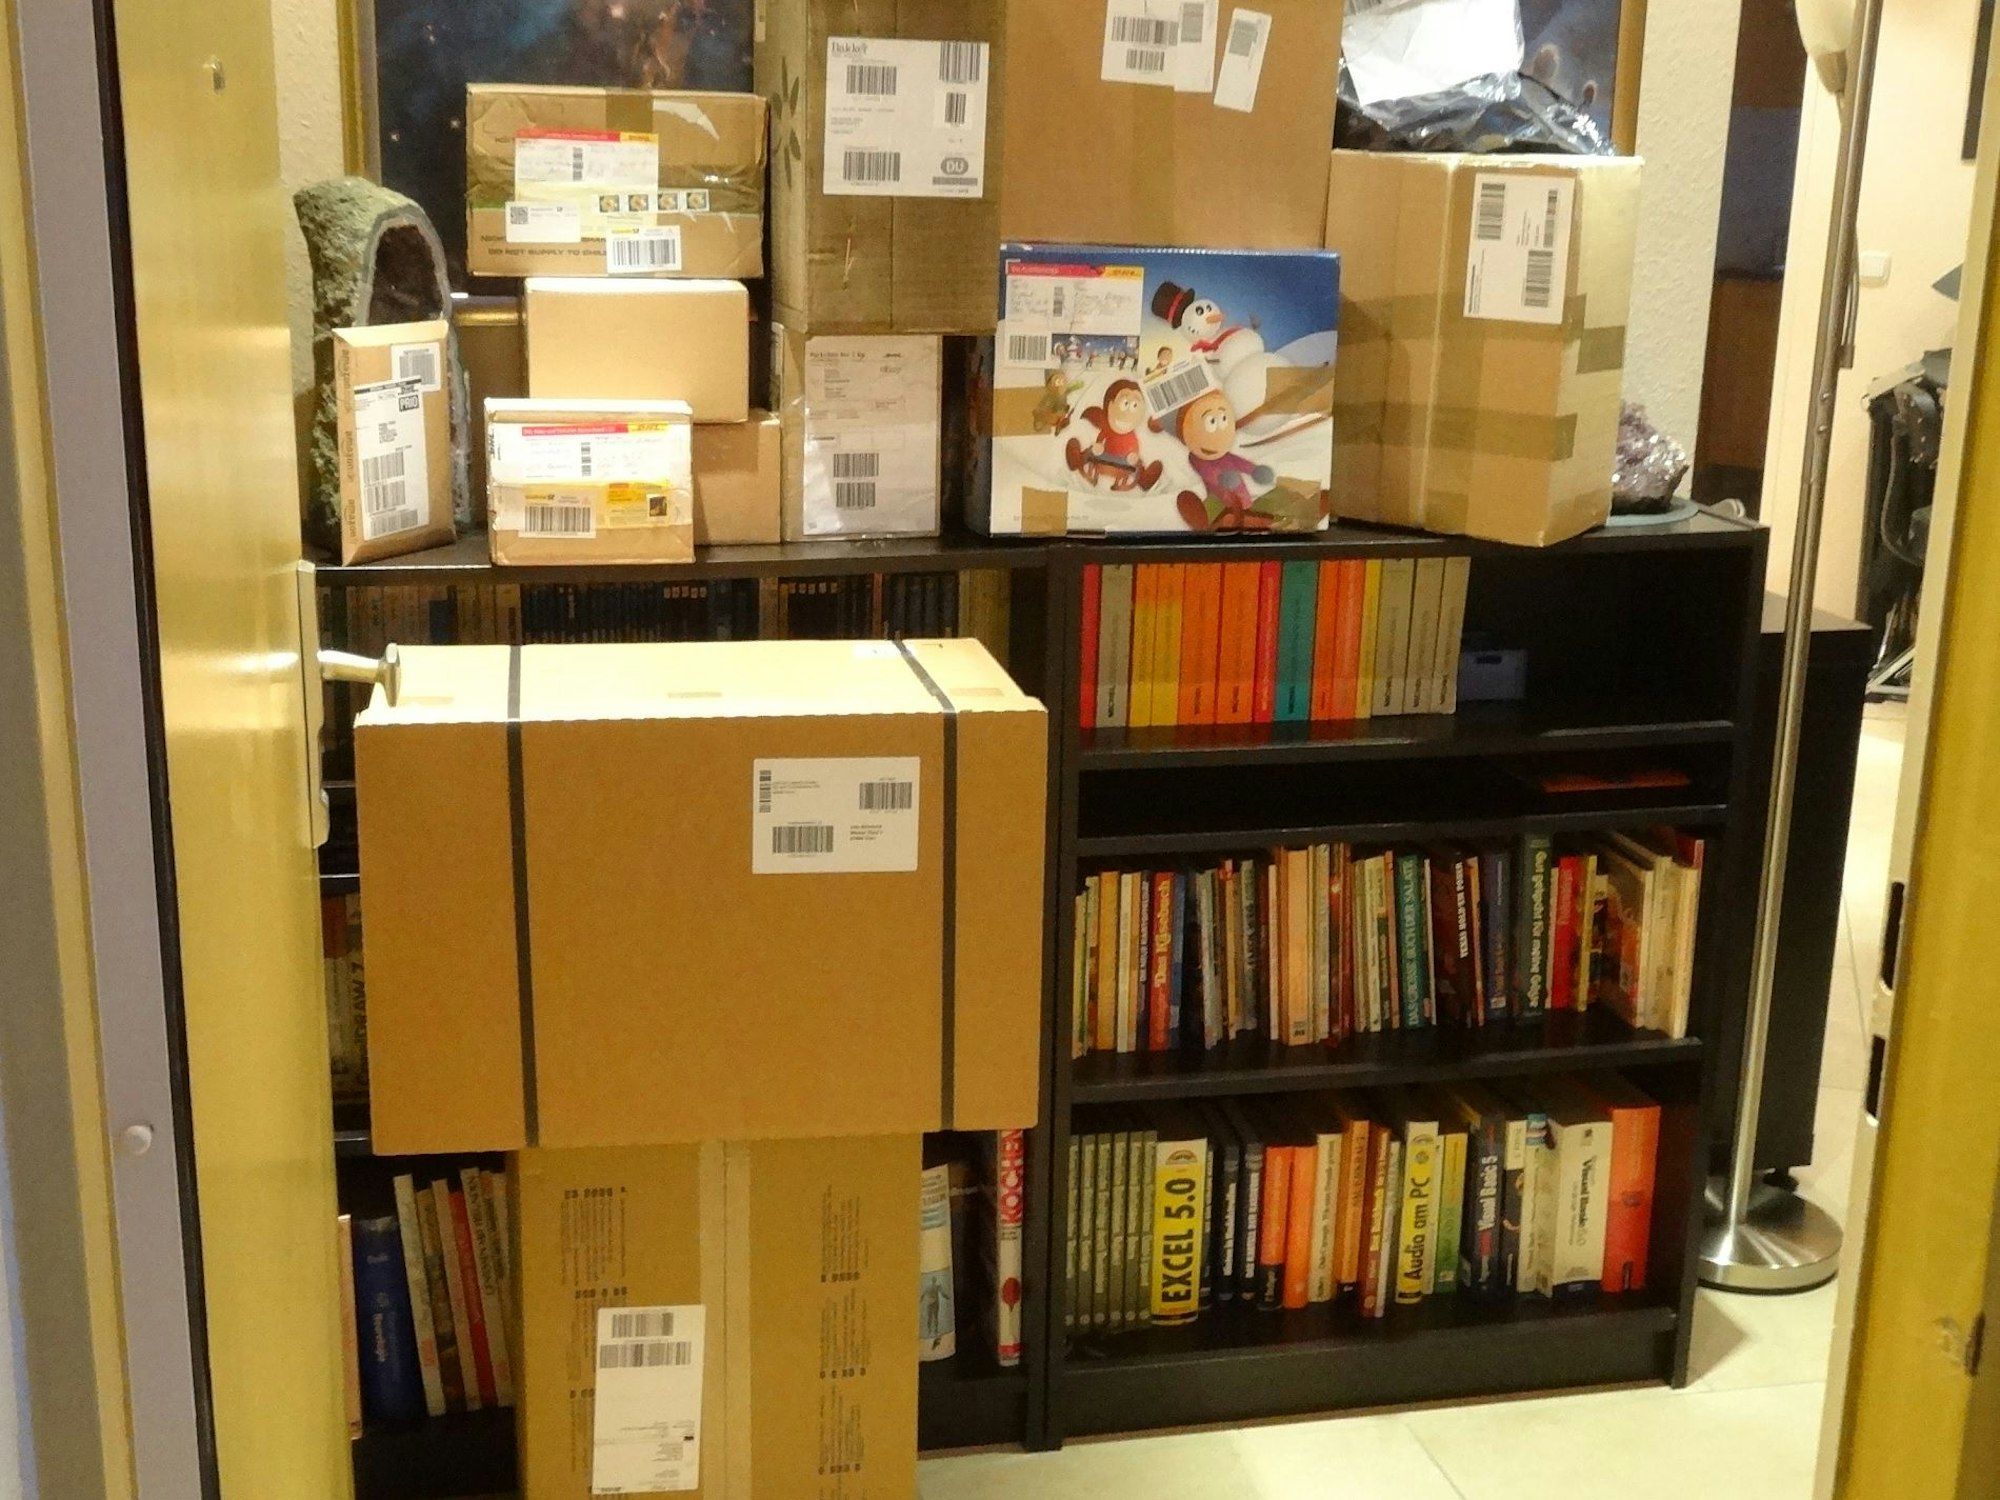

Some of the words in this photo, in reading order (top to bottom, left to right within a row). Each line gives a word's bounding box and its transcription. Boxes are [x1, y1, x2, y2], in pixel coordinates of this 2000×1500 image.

[528, 248, 563, 257] SUPPLY
[567, 248, 581, 257] TO
[582, 248, 606, 257] CHIL
[1405, 904, 1416, 929] DER
[1410, 1176, 1431, 1199] PC
[1479, 1164, 1498, 1198] Basic
[1582, 1159, 1593, 1195] Visual
[1164, 1177, 1197, 1220] 5.0
[1478, 1197, 1496, 1232] Visual
[1414, 1204, 1428, 1229] am
[1161, 1228, 1195, 1303] EXCEL
[1403, 1234, 1426, 1281] Audio
